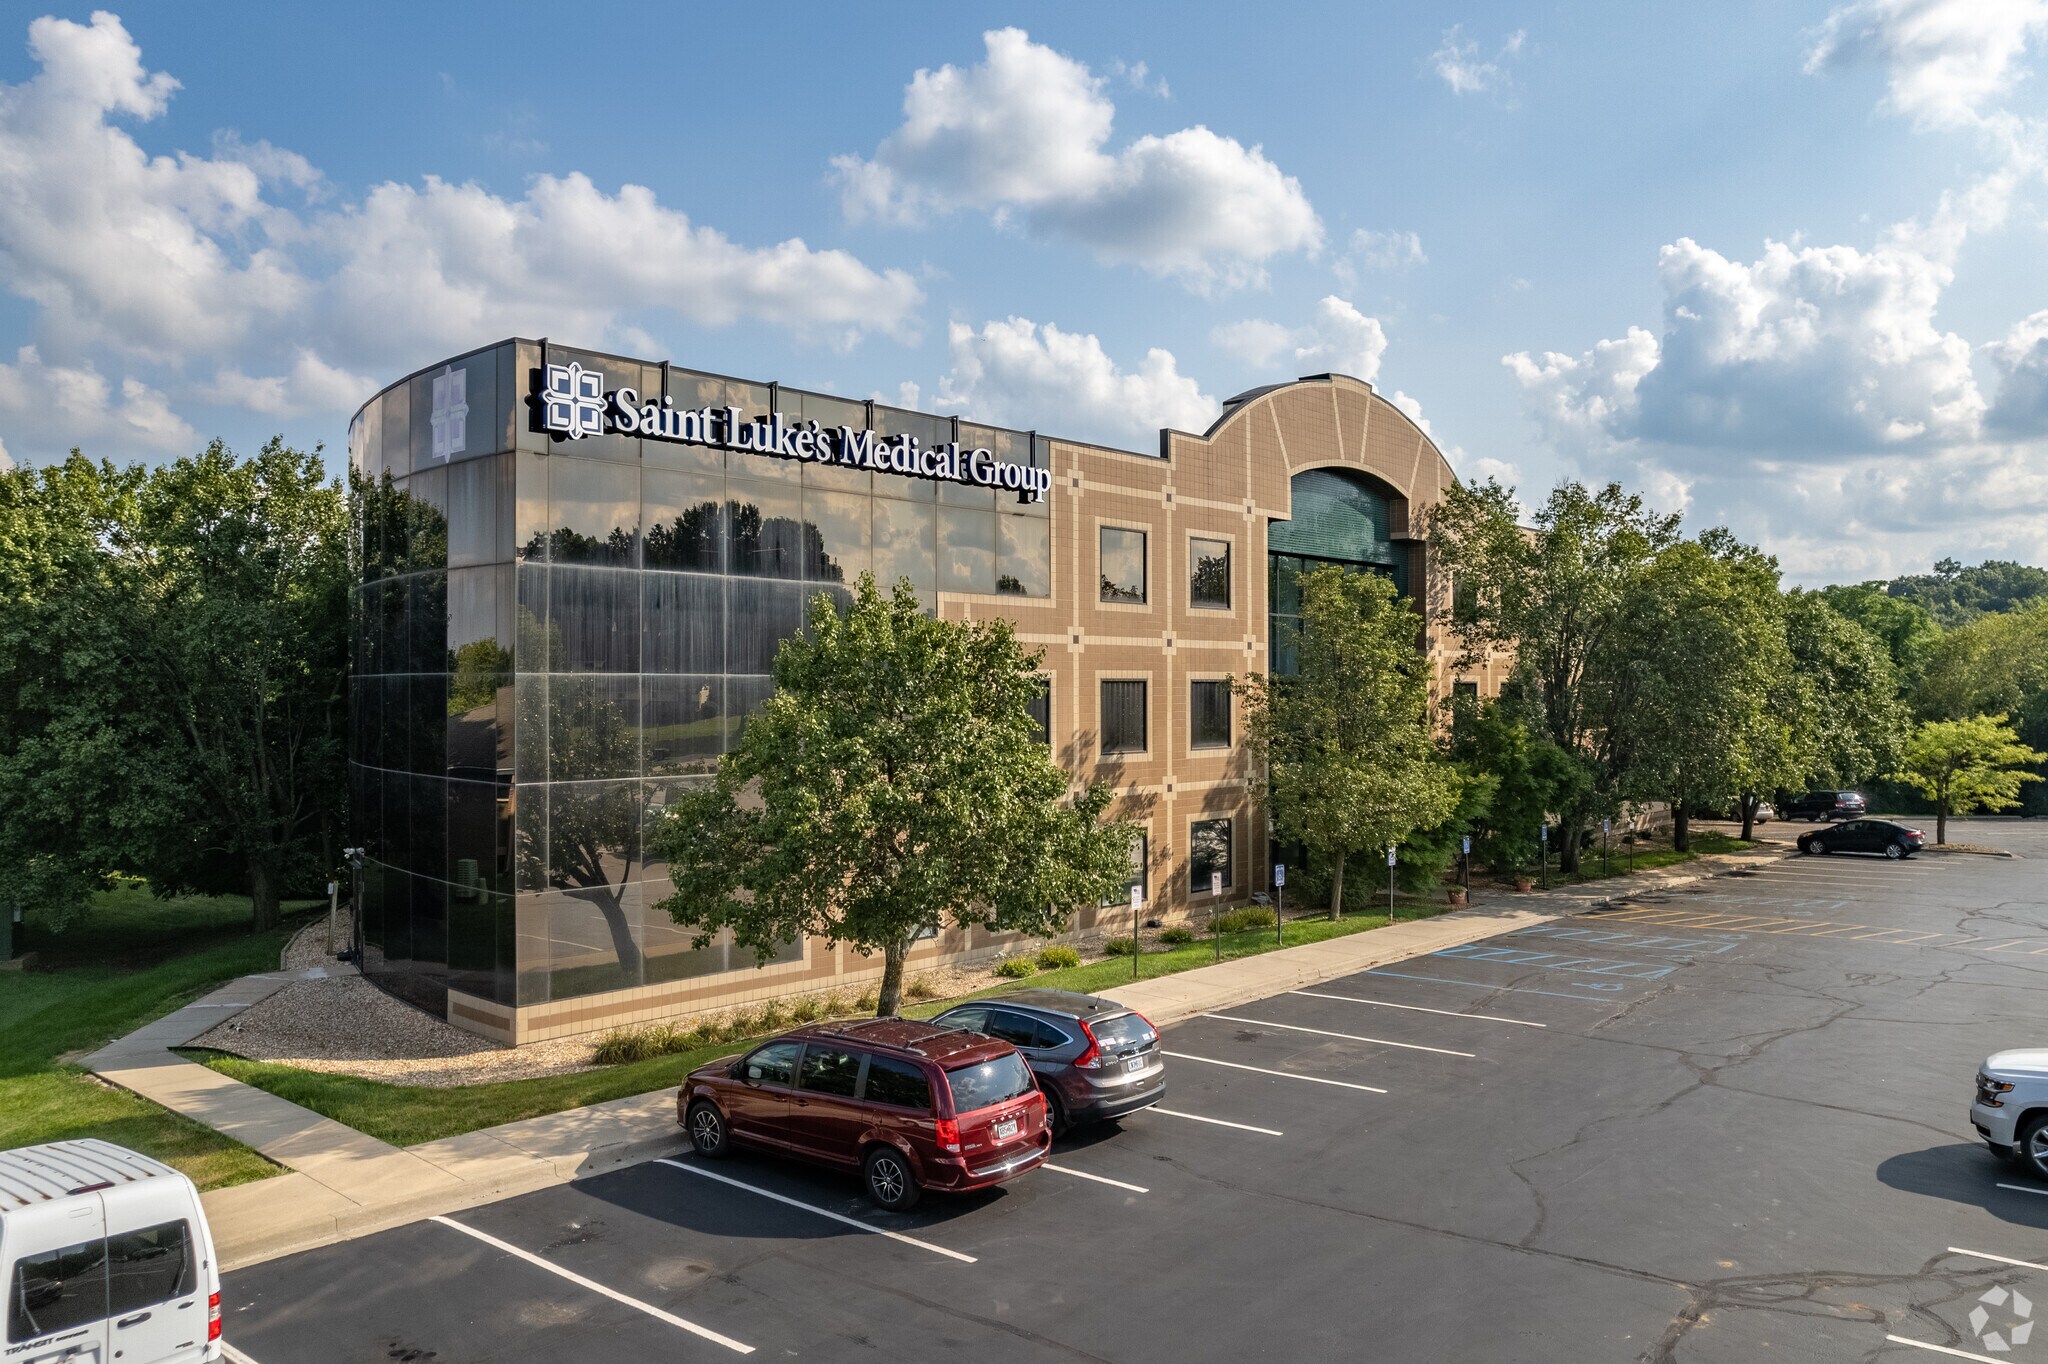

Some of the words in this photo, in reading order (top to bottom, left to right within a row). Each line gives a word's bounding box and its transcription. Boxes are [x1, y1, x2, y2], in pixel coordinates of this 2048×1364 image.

[614, 387, 717, 444] Saint
[727, 405, 831, 461] Luke's
[840, 425, 962, 480] Medical
[969, 448, 1052, 503] Group
